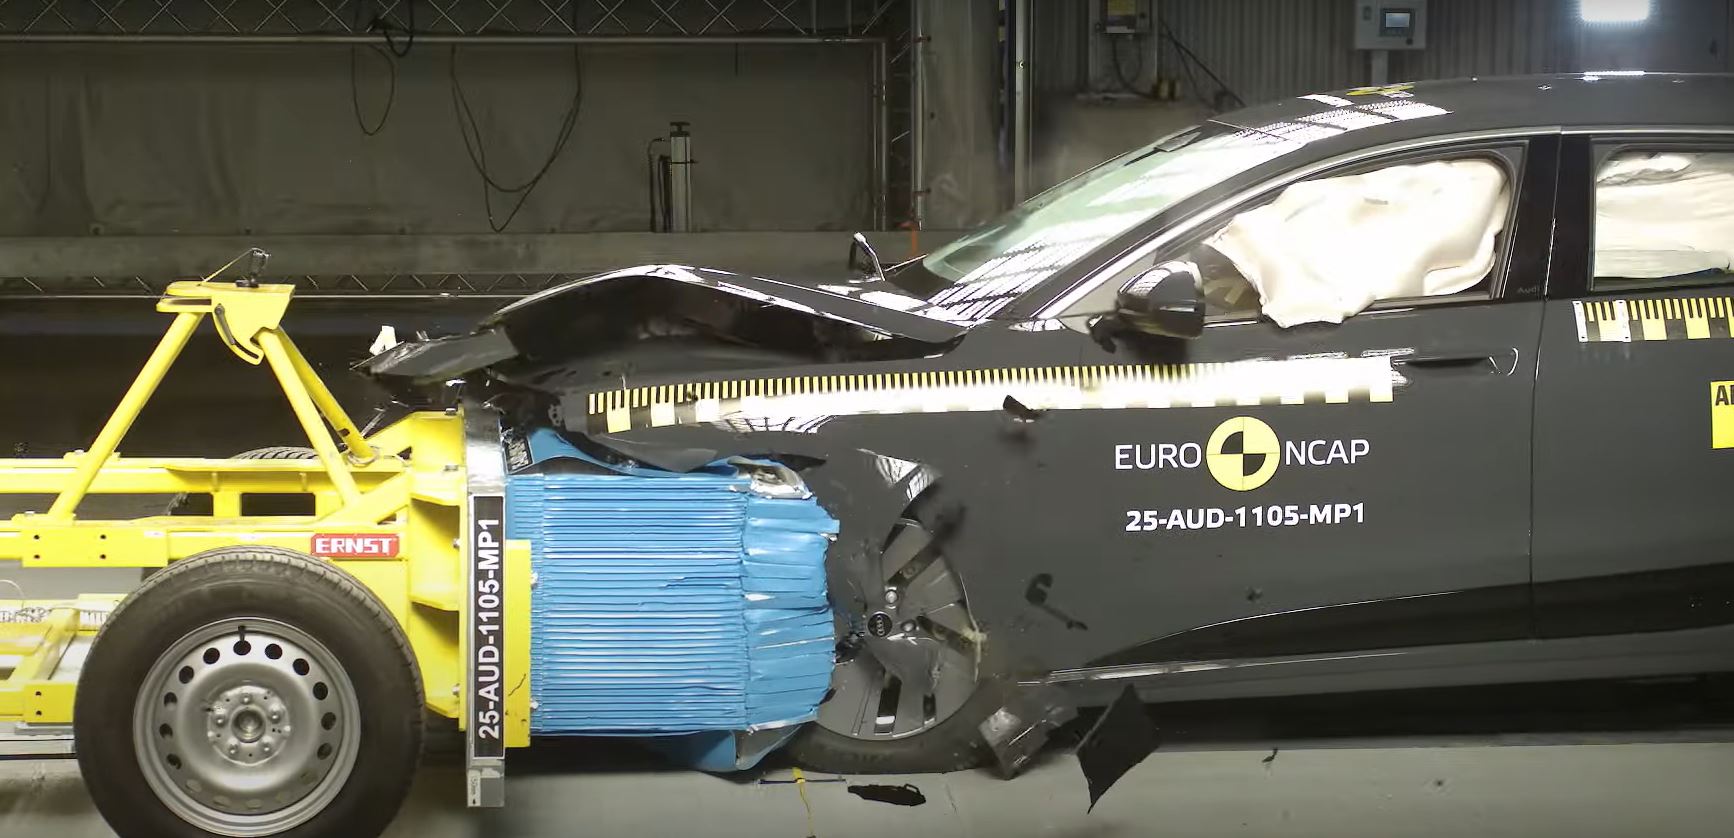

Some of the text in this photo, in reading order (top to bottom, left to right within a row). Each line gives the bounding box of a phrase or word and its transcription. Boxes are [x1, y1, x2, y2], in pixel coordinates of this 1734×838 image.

[1114, 438, 1370, 470] EURO NCAP
[1124, 502, 1365, 532] 25-AUD-1105-MP1
[315, 537, 393, 554] ERNST
[478, 518, 500, 740] 25-AUD-1105-MP1
